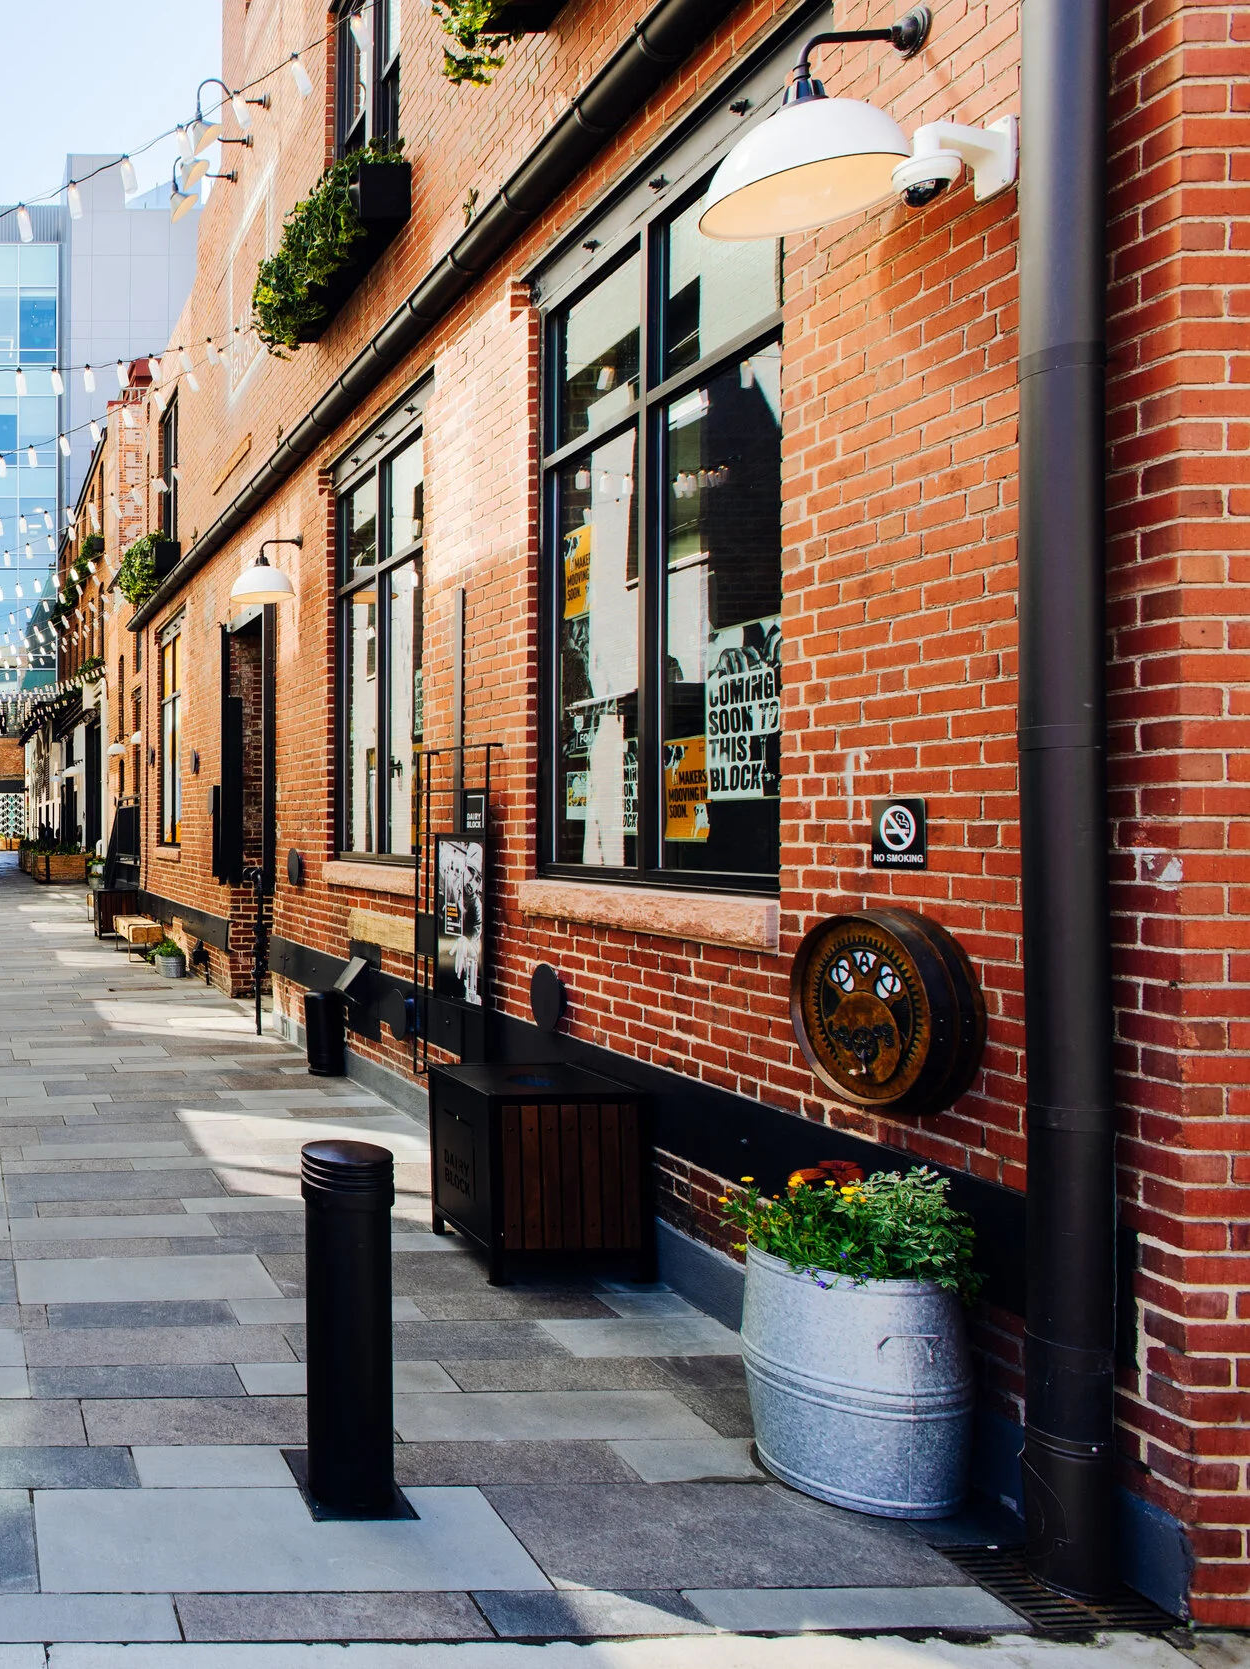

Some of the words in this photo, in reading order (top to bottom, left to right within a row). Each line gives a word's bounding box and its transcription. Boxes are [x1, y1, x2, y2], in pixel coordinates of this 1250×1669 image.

[709, 671, 774, 708] COMING
[708, 704, 753, 736] SOON
[759, 701, 779, 730] TO
[708, 735, 747, 763] THIS
[678, 769, 707, 785] MAKERS
[710, 763, 762, 792] BLOCK
[668, 787, 699, 803] MOOVING
[467, 812, 481, 820] DAIRY
[669, 804, 688, 818] SOON.
[467, 820, 481, 828] BLOCK
[873, 854, 885, 862] NO
[886, 854, 924, 863] SMOKING
[444, 1148, 469, 1178] DAIRY
[444, 1167, 471, 1198] BLOCK
